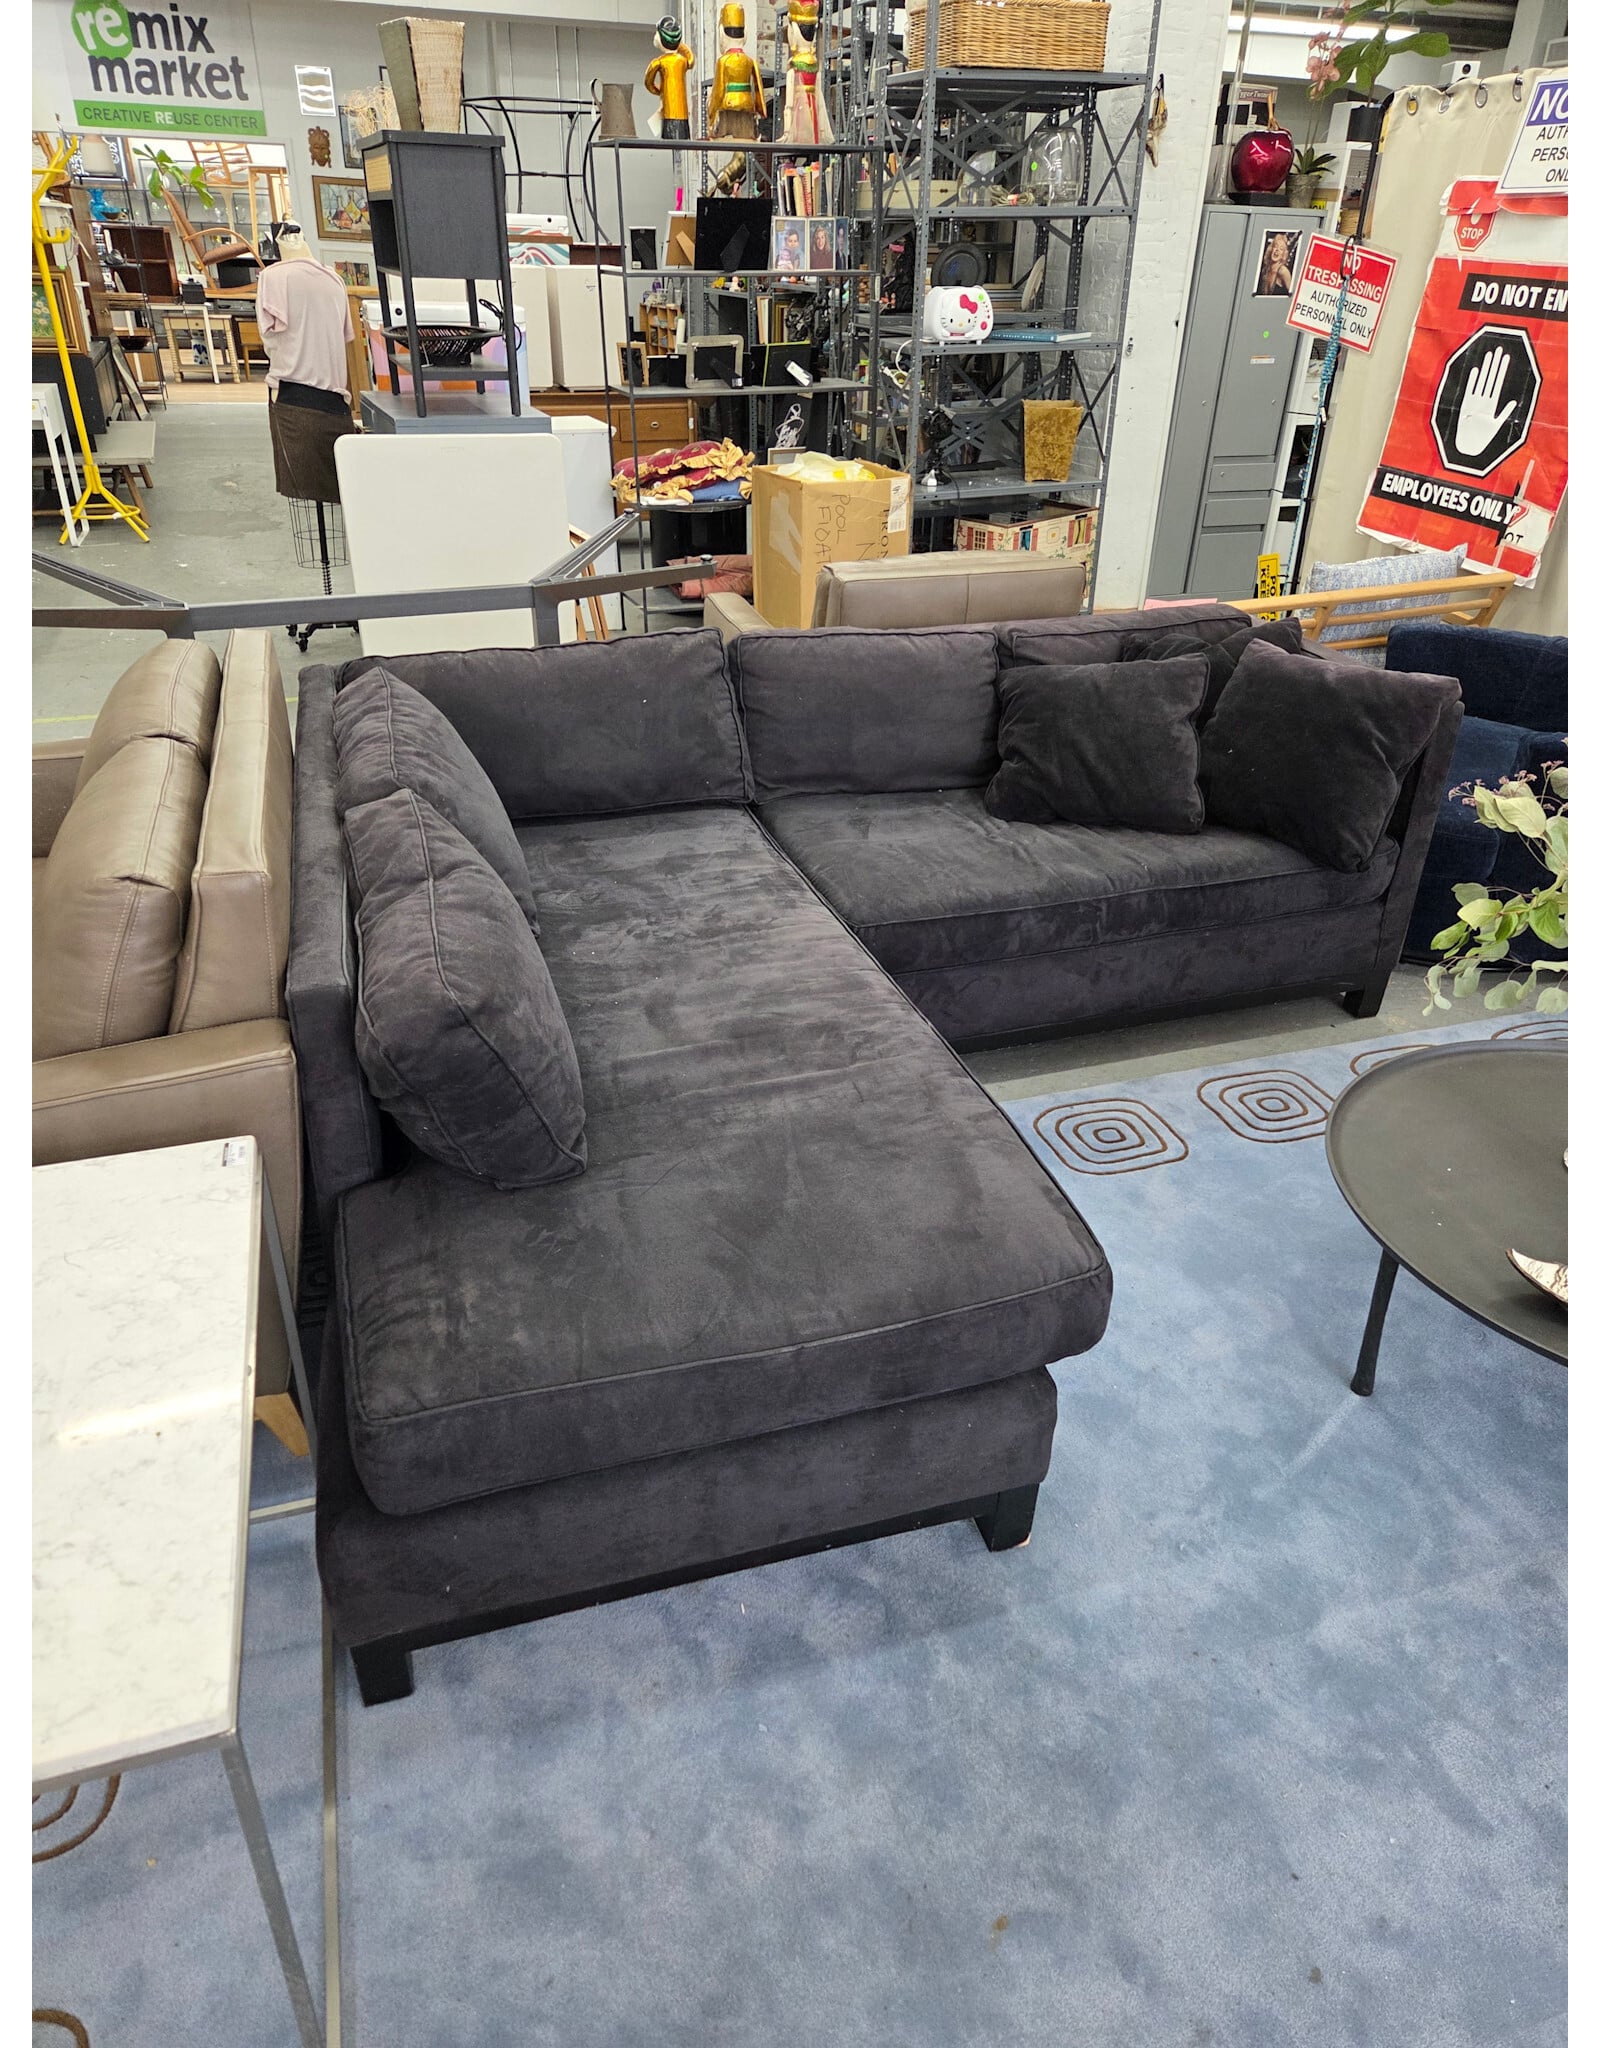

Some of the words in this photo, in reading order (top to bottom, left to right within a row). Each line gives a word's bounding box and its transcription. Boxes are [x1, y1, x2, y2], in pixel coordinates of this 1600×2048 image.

[74, 3, 215, 53] remix
[88, 55, 249, 101] market
[82, 107, 152, 124] CREATIVE
[154, 111, 201, 126] REUSE
[203, 114, 258, 129] CENTER
[1530, 147, 1568, 162] PERS
[1460, 227, 1484, 240] STOP
[1343, 253, 1361, 271] NO
[1307, 265, 1383, 300] TRESPSSING
[1471, 281, 1498, 304] DO
[1500, 284, 1543, 309] NOT
[1349, 321, 1375, 339] ONLY
[1381, 472, 1469, 513] EMPLOYEES
[1469, 495, 1519, 524] ONLY
[832, 494, 850, 544] POOL
